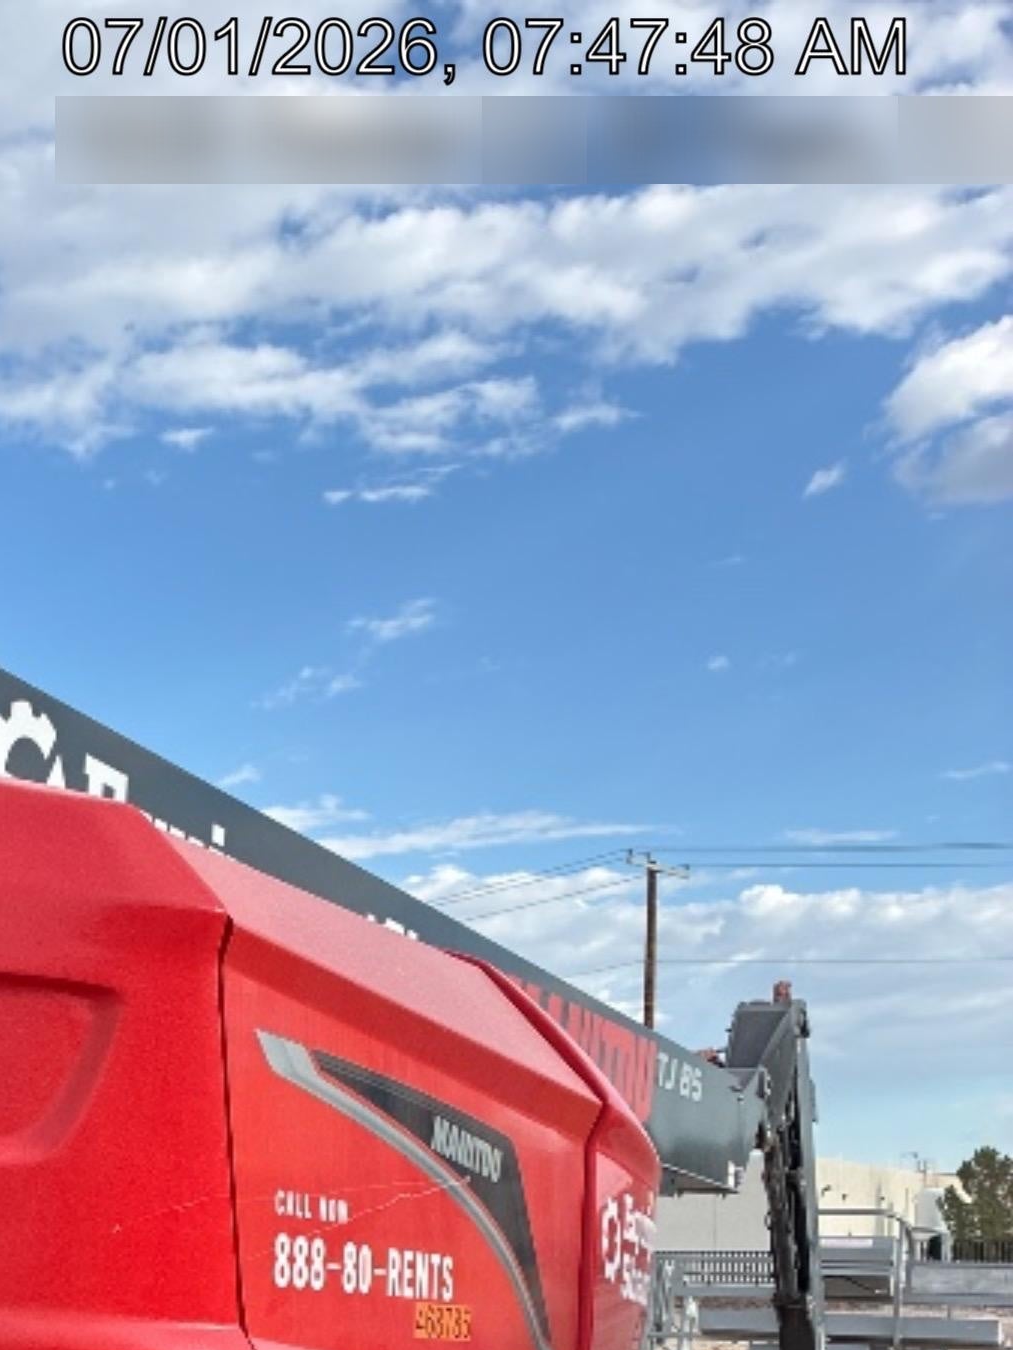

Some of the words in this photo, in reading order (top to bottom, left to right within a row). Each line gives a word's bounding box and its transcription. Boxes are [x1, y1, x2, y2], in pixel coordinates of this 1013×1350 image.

[657, 1052, 676, 1091] TJ
[680, 1064, 703, 1101] 85
[431, 1115, 503, 1183] MANITOU
[275, 1189, 312, 1219] CALL
[319, 1196, 348, 1224] NOW
[274, 1232, 454, 1302] 888-80-RENTS
